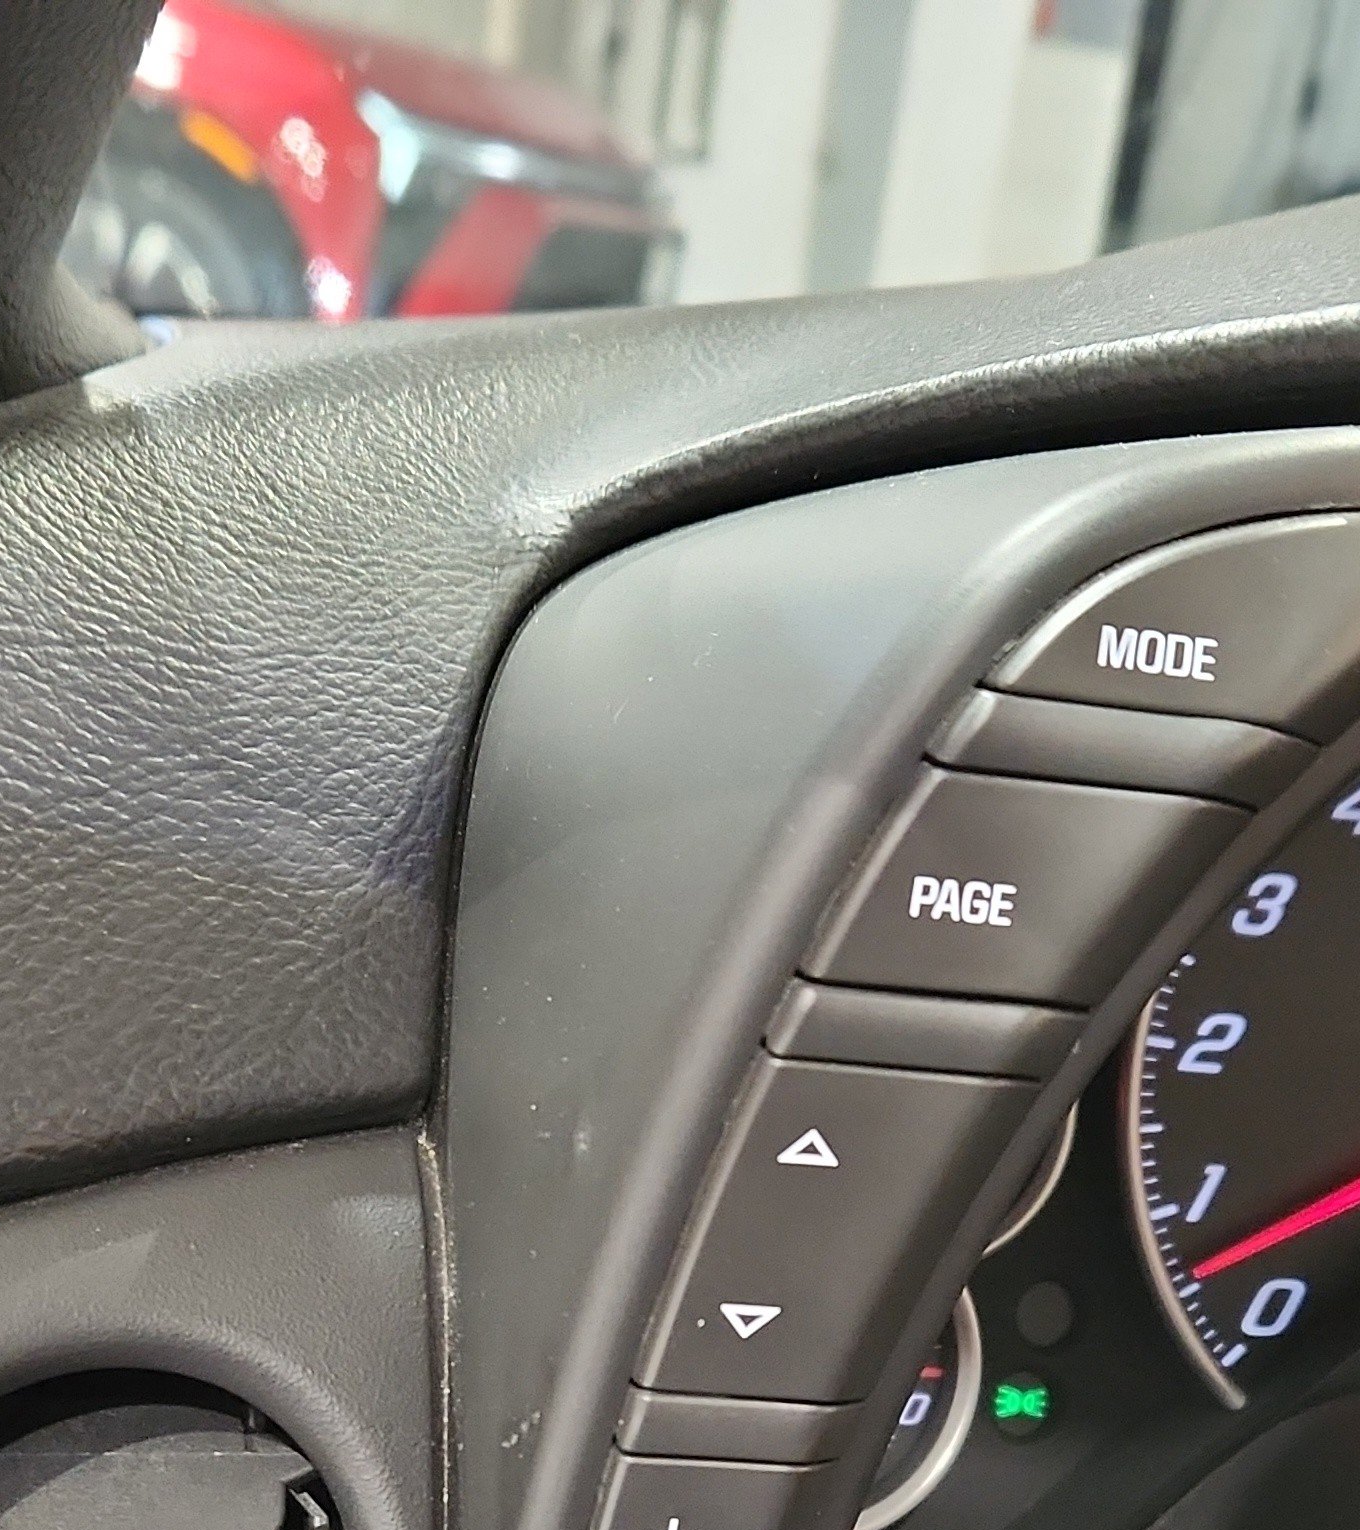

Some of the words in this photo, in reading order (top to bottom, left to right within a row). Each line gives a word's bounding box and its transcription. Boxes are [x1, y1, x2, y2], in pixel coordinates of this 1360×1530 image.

[1097, 625, 1218, 681] MODE
[908, 876, 1017, 927] PAGE
[1231, 873, 1297, 937] 3
[1176, 1012, 1247, 1075] 2
[1185, 1164, 1226, 1223] 1
[1241, 1278, 1306, 1337] 0
